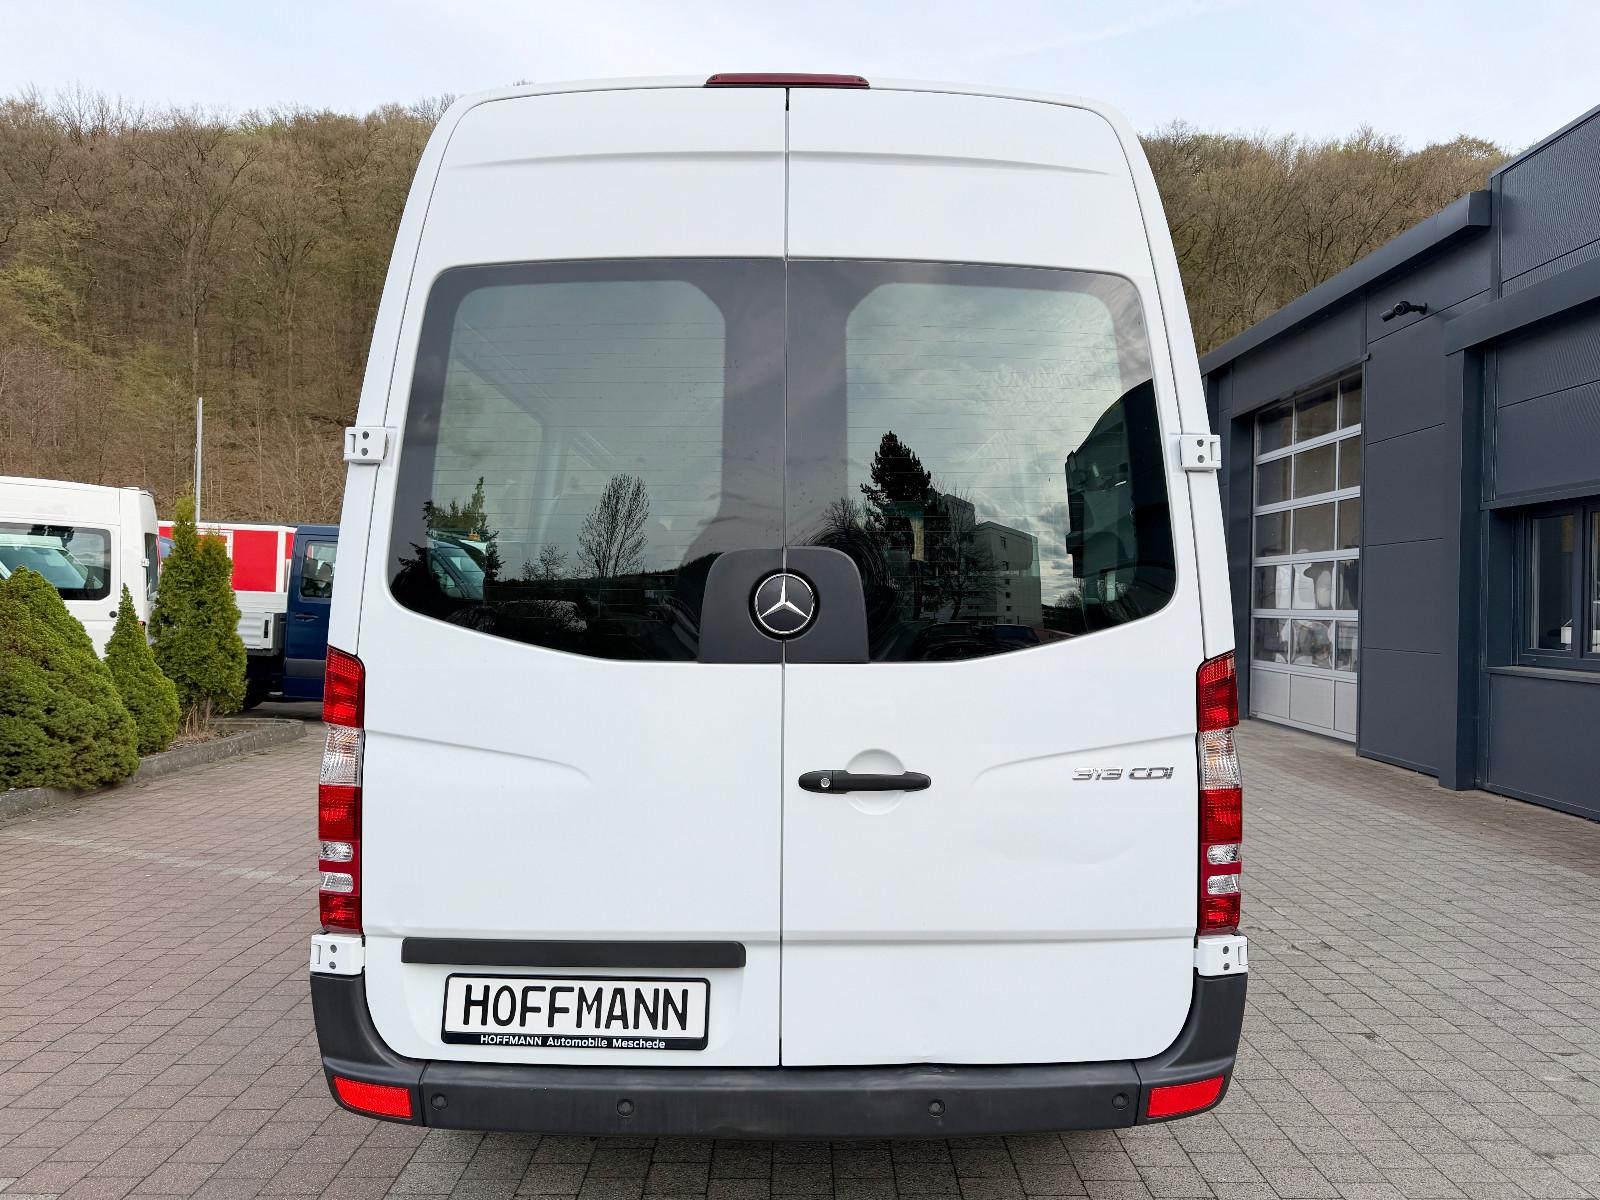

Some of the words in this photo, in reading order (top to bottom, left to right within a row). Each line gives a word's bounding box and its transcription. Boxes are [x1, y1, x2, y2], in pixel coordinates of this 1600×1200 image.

[1072, 767, 1123, 780] 313
[1128, 766, 1174, 780] CDI
[462, 984, 689, 1031] HOFFMANN
[480, 1035, 542, 1046] HOFFMANN
[546, 1037, 608, 1048] Automobile
[612, 1038, 666, 1049] Meschede
